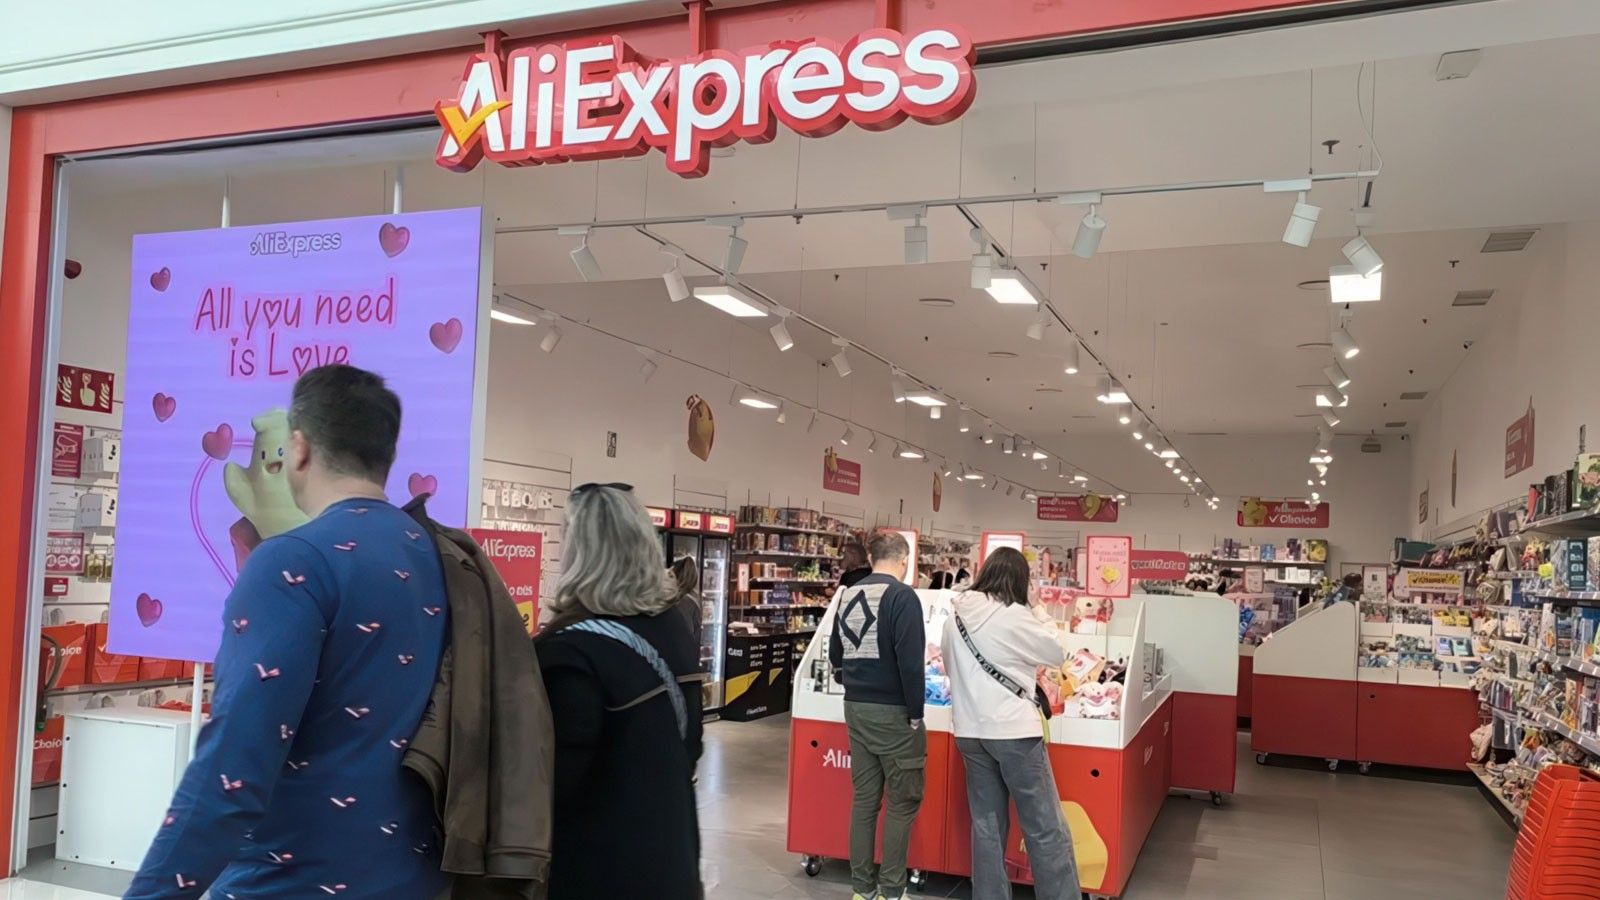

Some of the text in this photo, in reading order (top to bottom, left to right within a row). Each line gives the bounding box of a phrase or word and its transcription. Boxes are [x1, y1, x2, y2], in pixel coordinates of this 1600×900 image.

[441, 29, 961, 162] AliExpress
[250, 231, 342, 258] AliExpress
[195, 277, 394, 340] All you need
[230, 333, 349, 377] is Love
